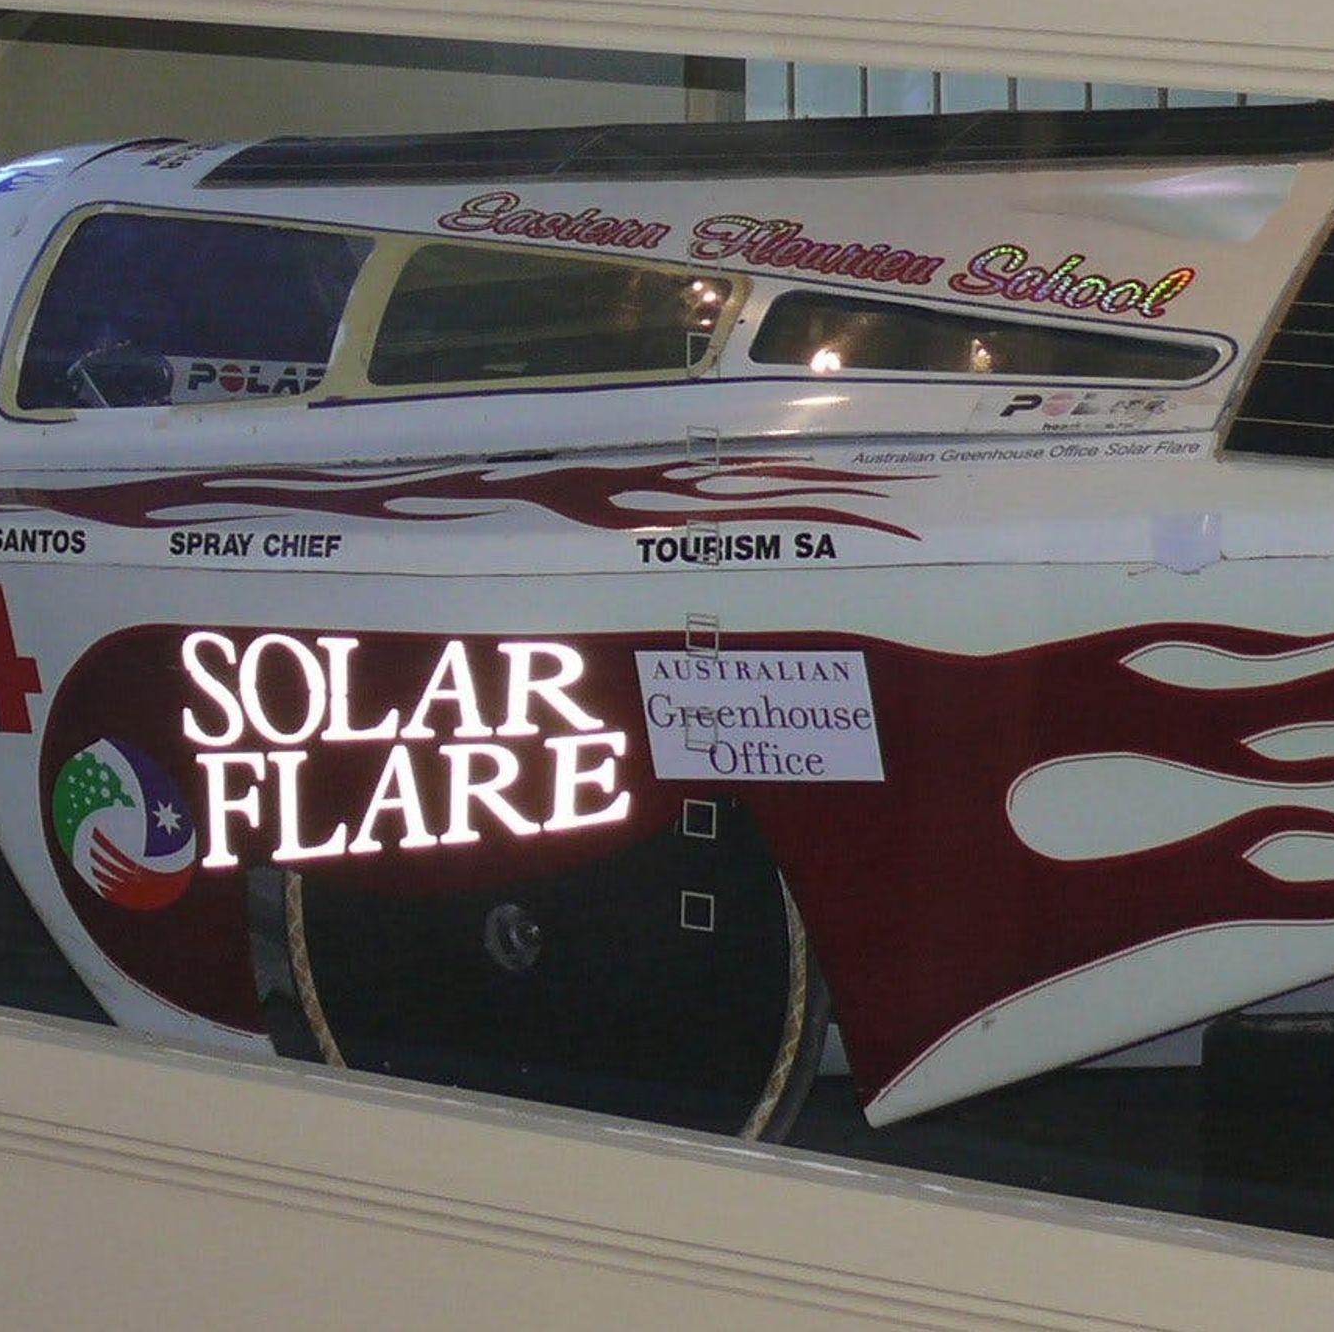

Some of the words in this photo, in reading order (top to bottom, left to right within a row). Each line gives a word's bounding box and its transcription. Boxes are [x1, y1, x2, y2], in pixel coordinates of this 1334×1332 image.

[438, 190, 670, 249] Eastern
[689, 214, 944, 285] Fleurieu
[948, 241, 1196, 318] School
[851, 450, 936, 465] Australian
[940, 446, 1045, 464] Greenhouse
[1050, 443, 1099, 459] Office
[1104, 440, 1152, 457] Solar
[1155, 438, 1202, 455] Flare
[169, 531, 255, 557] SPRAY
[262, 533, 342, 559] CHIEF
[636, 533, 781, 564] TOURISM
[794, 532, 837, 560] SA
[180, 630, 606, 747] SOLAR
[651, 659, 852, 682] AUSTRALIAN
[646, 692, 873, 731] Greenhouse
[708, 740, 824, 776] Office
[194, 730, 631, 868] FLARE
